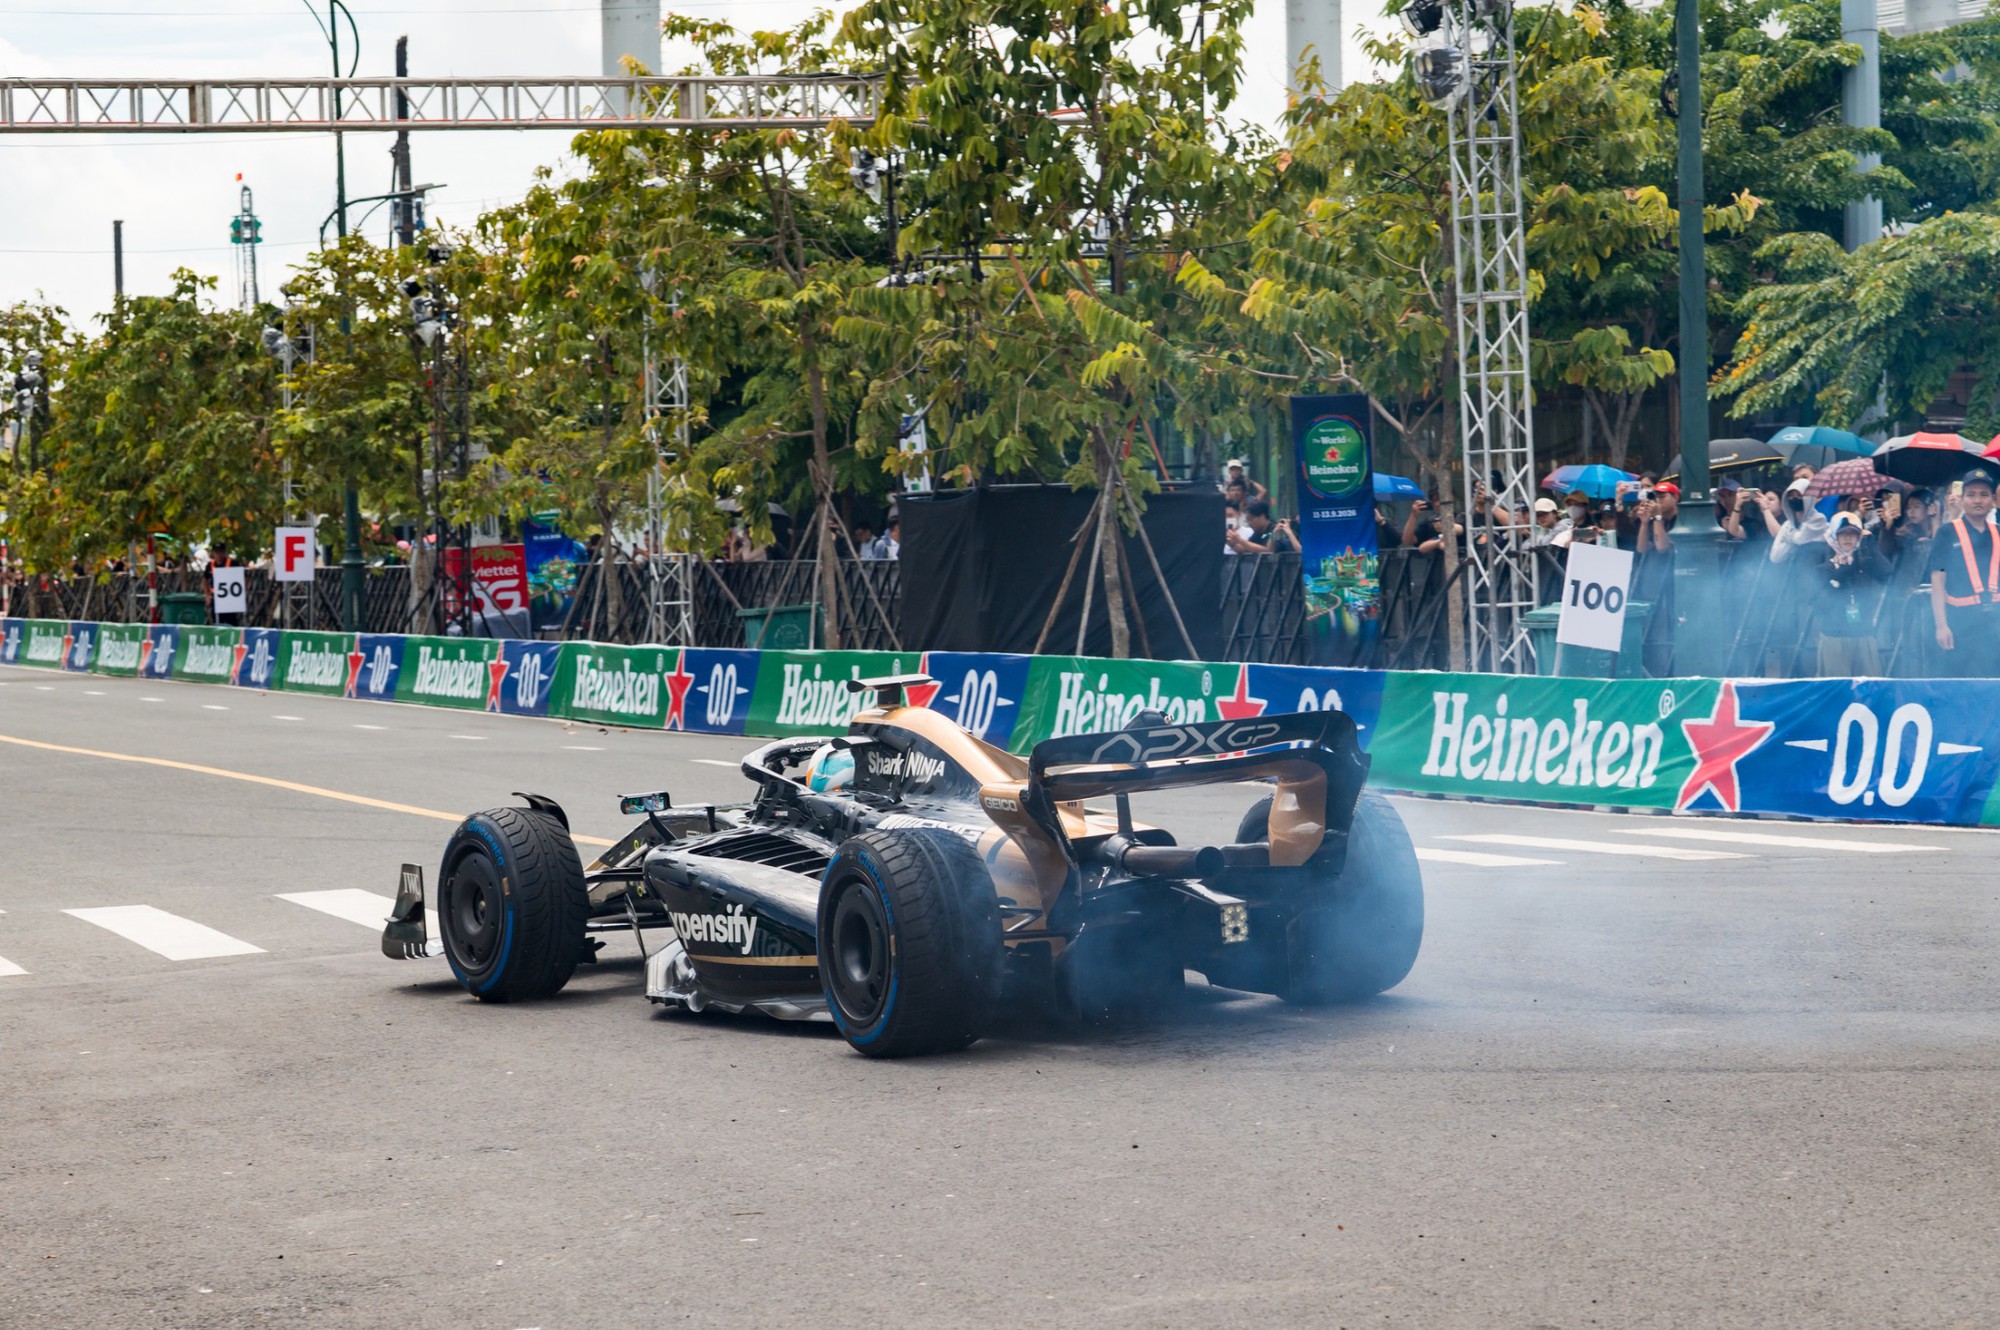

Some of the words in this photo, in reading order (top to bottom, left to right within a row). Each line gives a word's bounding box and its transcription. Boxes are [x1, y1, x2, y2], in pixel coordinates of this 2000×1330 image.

[1320, 436, 1347, 445] World
[1309, 464, 1359, 475] Heineken
[285, 536, 305, 572] F
[473, 565, 519, 577] viettel
[217, 581, 243, 598] 50
[1570, 579, 1623, 614] 100
[287, 640, 344, 686] Heineken
[413, 646, 485, 699] Heineken
[572, 654, 659, 716] Heineken
[706, 663, 738, 726] 0.0
[776, 663, 879, 727] Heinek
[956, 668, 998, 740] 00
[1421, 691, 1664, 788] Heineken
[1826, 702, 1933, 807] 0.0
[868, 752, 904, 776] Shark
[905, 752, 945, 783] NINJA
[984, 797, 1017, 812] GEICO
[662, 904, 757, 955] xpensify
